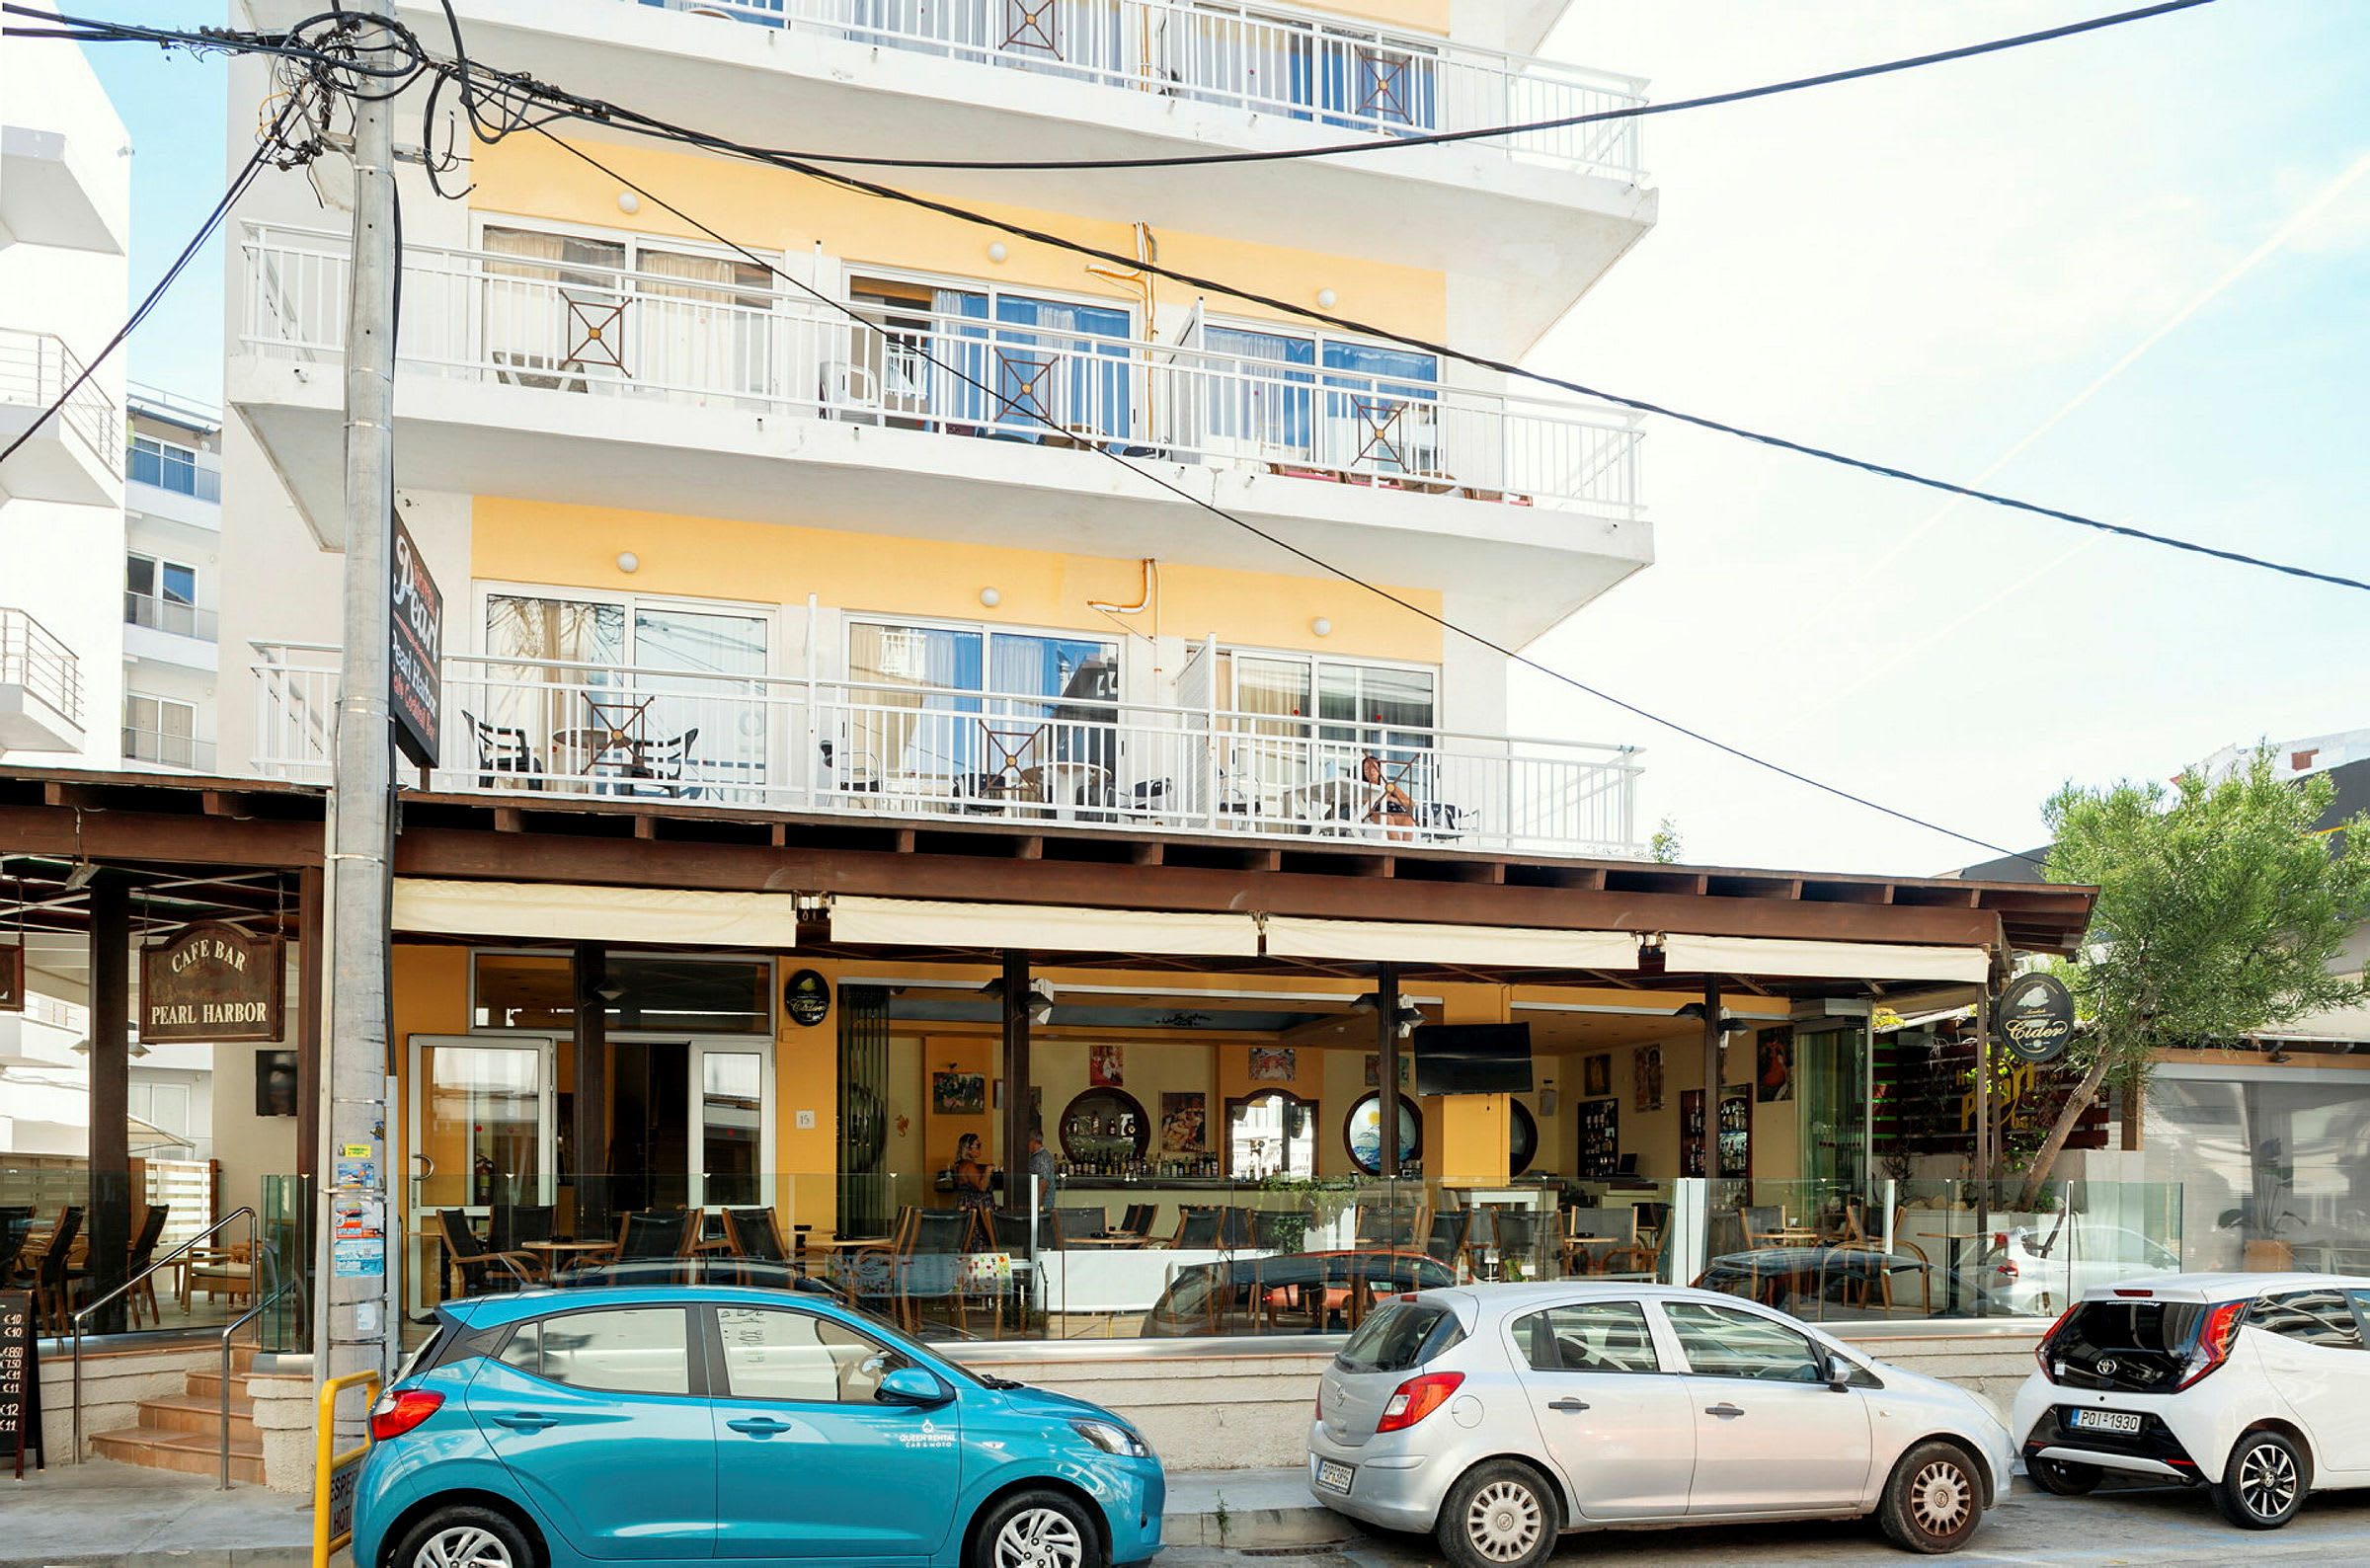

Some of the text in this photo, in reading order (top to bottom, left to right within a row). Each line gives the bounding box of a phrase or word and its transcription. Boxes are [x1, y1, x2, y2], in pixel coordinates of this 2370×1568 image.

[394, 534, 440, 664] Pearl
[412, 659, 436, 718] Harbor
[172, 939, 246, 974] CAFE BAR
[151, 1001, 267, 1025] PEARL HARBOR
[2006, 1019, 2068, 1040] Cider
[1961, 1060, 2034, 1133] Parl
[800, 1114, 810, 1127] 15
[4, 1313, 22, 1325] €10
[4, 1326, 23, 1338] €10
